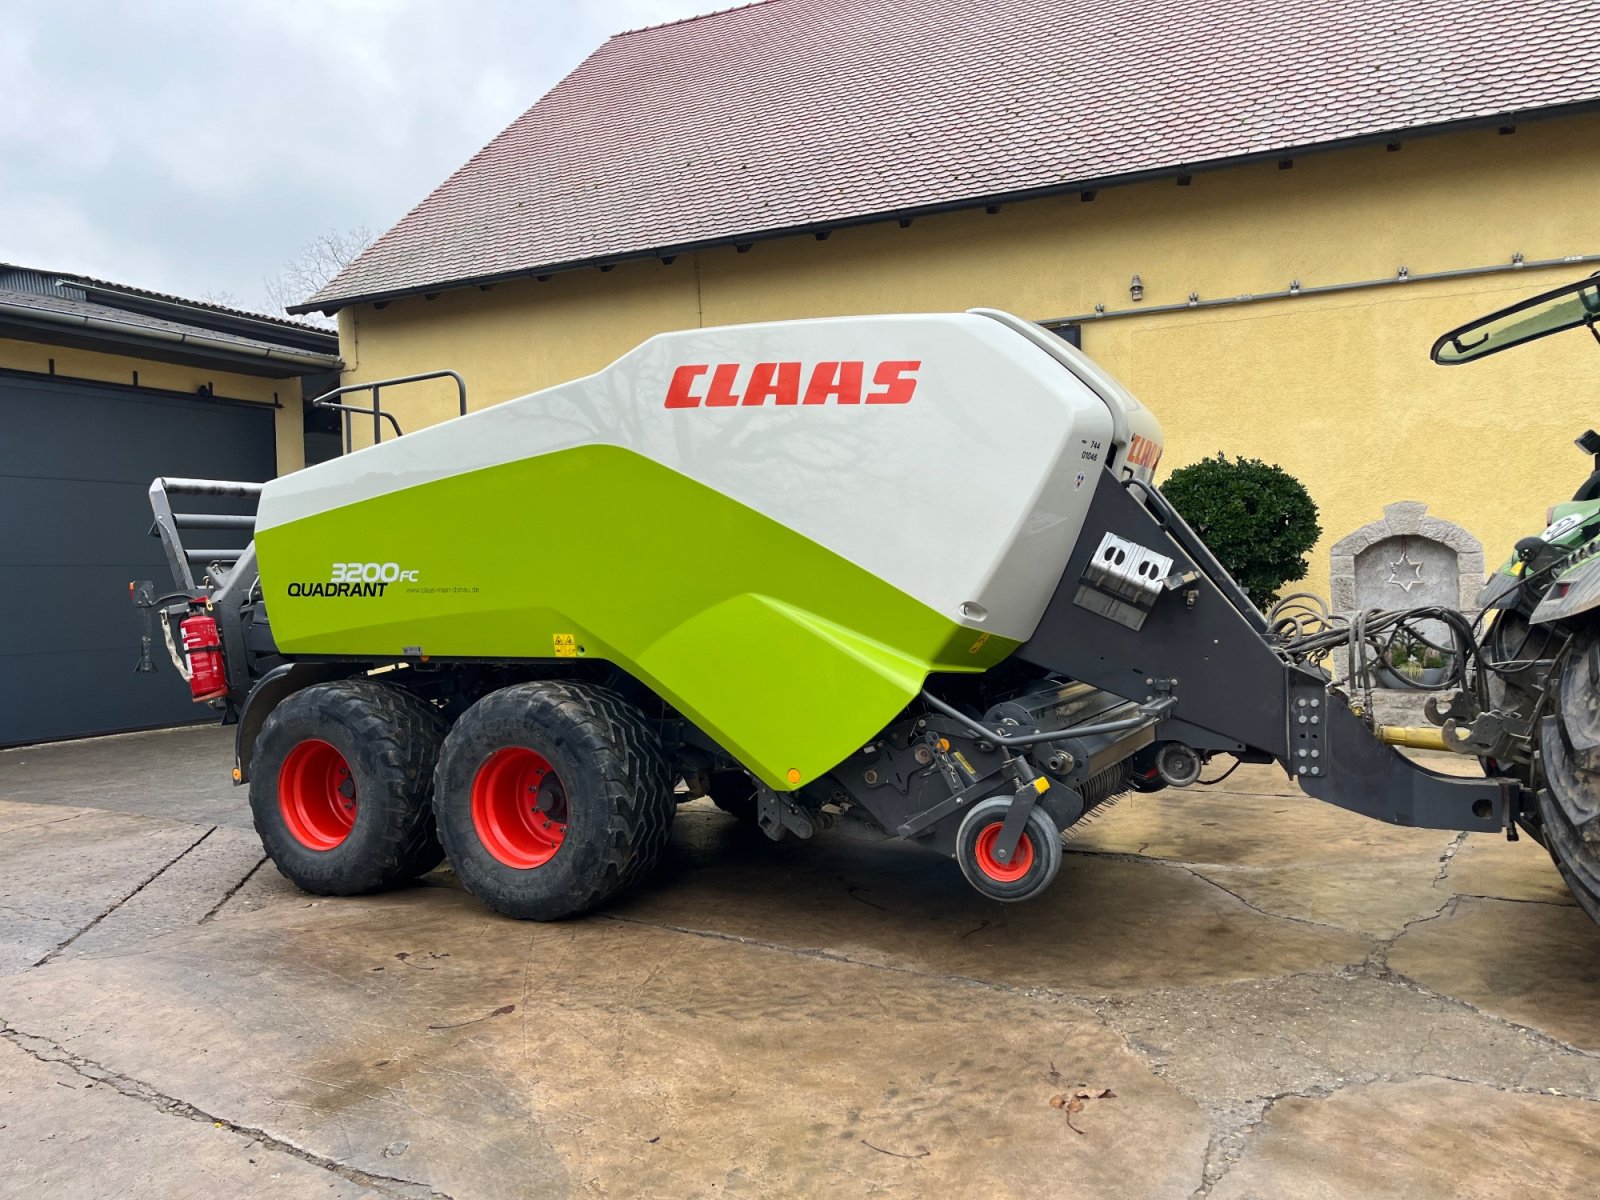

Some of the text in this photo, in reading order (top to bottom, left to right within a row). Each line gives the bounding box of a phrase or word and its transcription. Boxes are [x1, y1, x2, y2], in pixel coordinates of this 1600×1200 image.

[664, 361, 921, 408] CLAAS
[1090, 440, 1101, 450] 744
[330, 562, 420, 583] 3200 FC
[287, 582, 389, 597] QUADRANT
